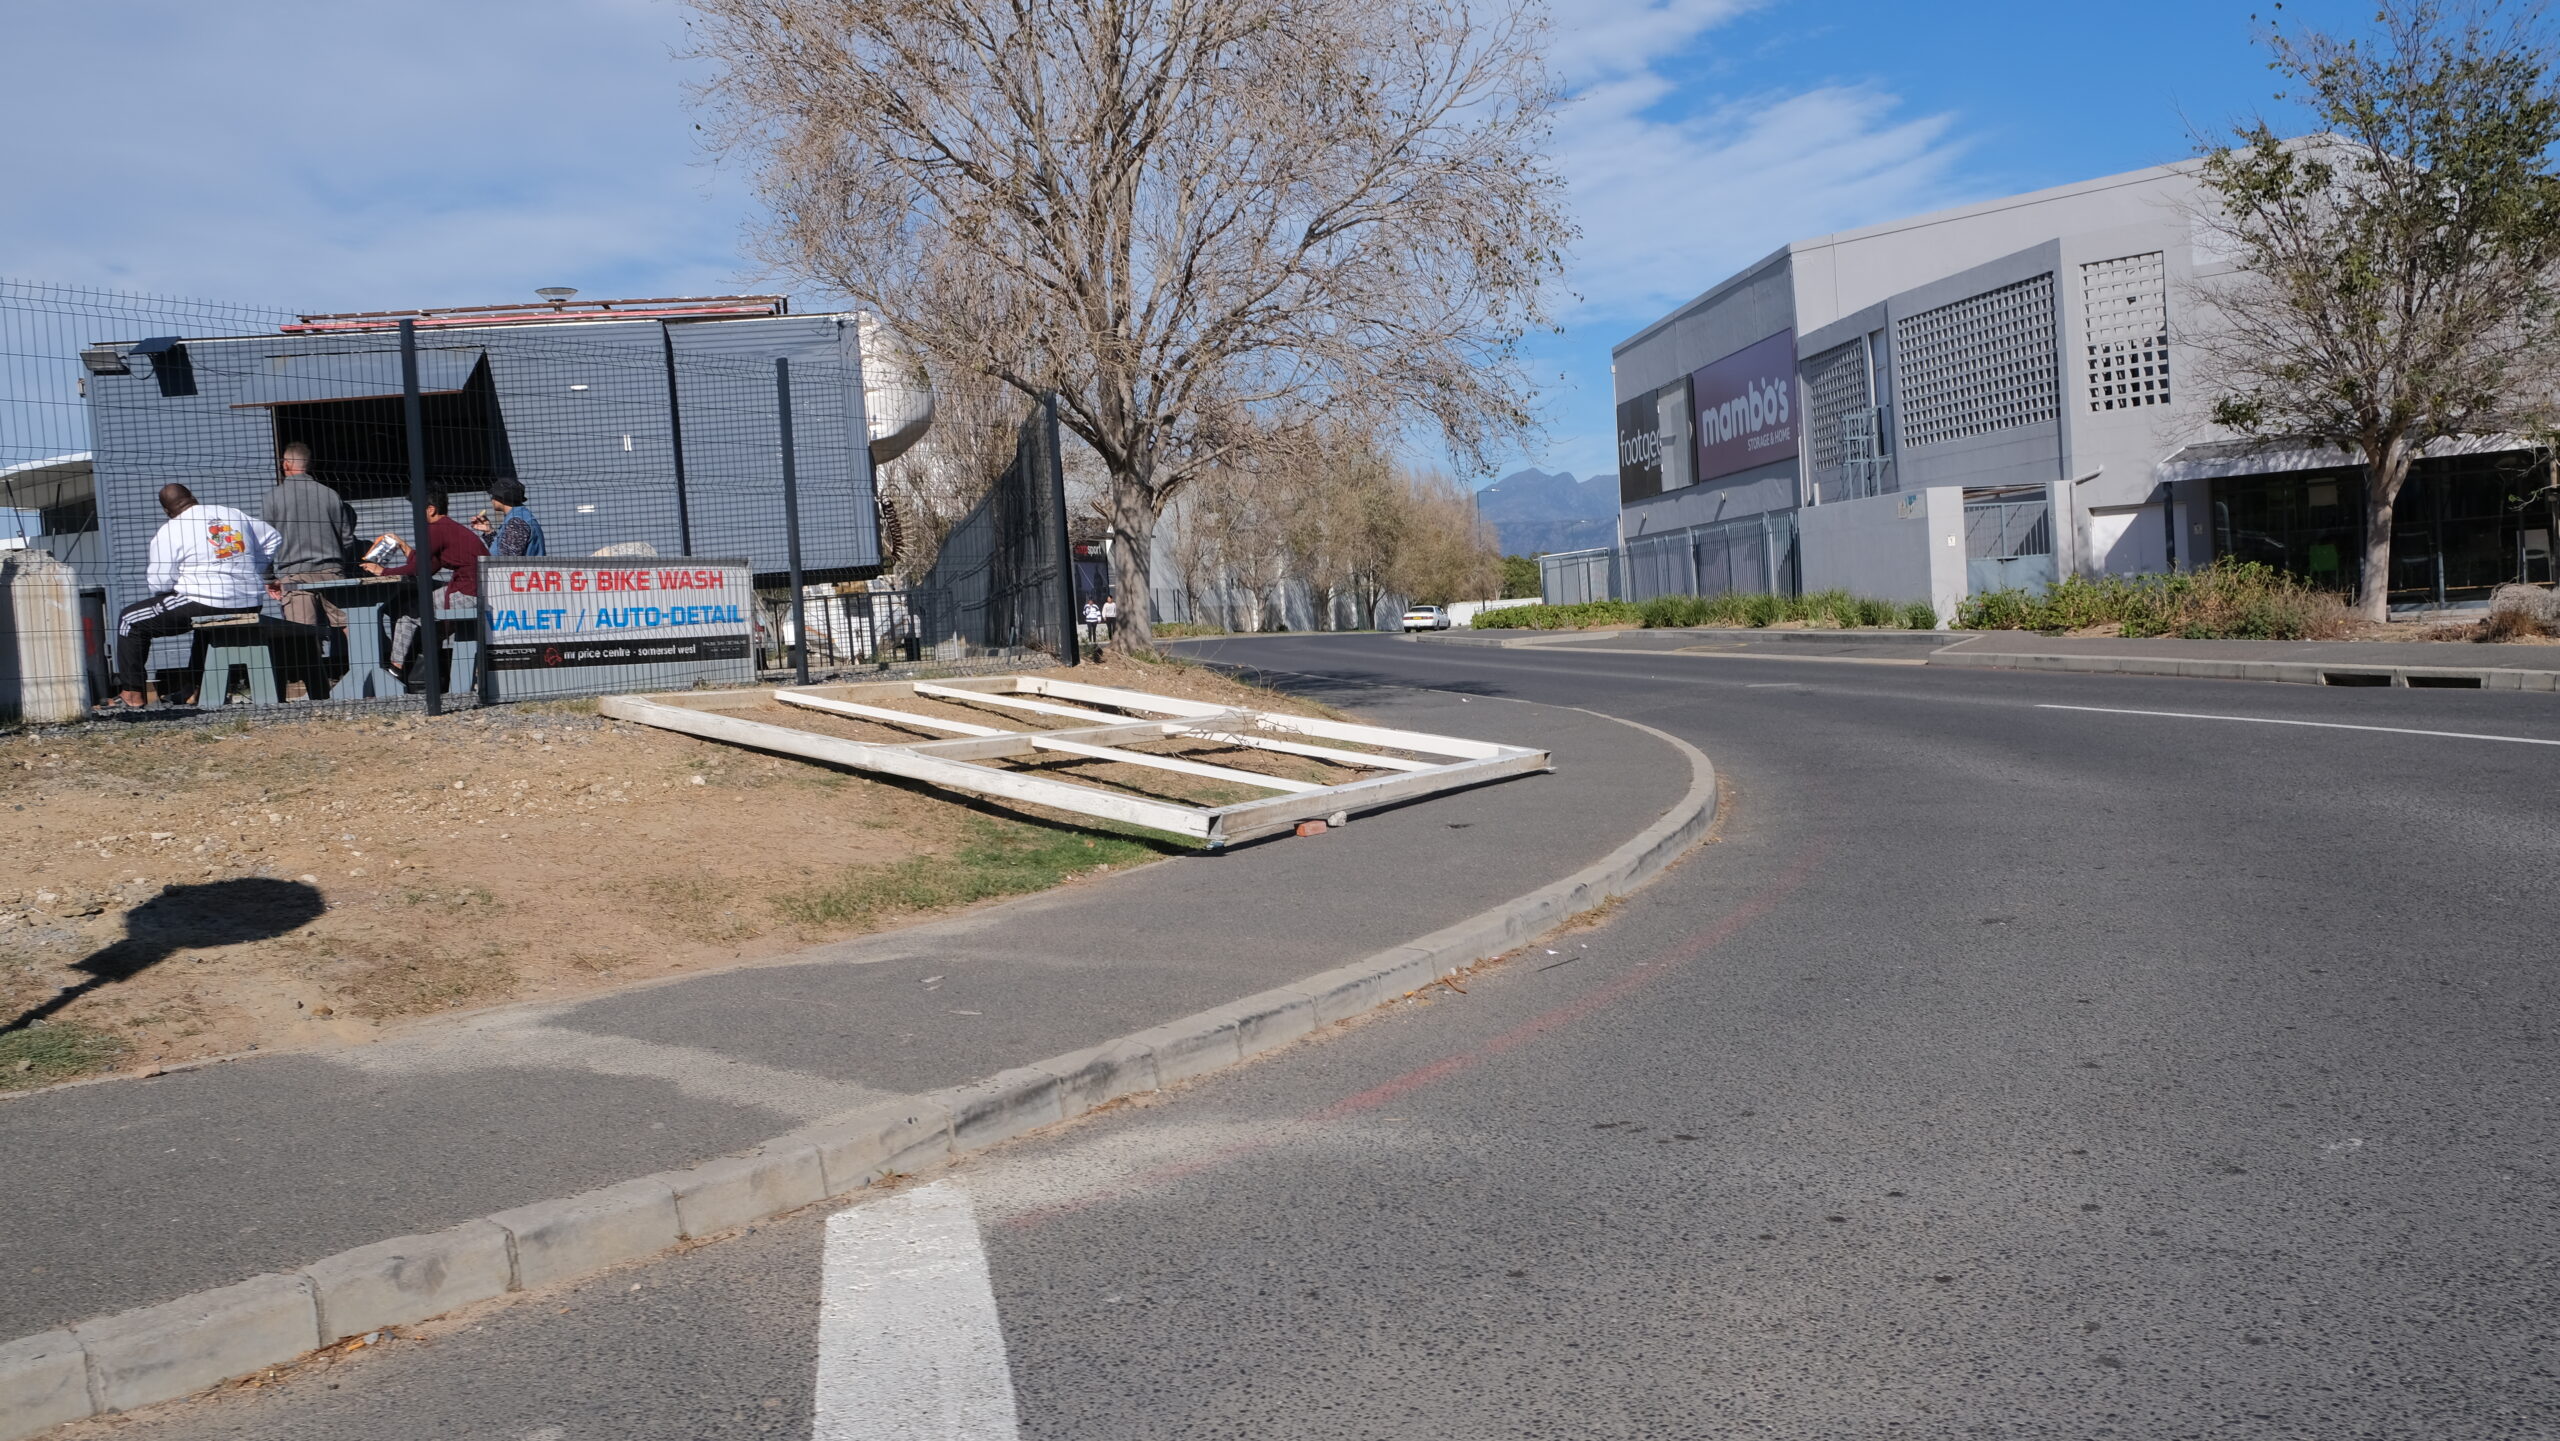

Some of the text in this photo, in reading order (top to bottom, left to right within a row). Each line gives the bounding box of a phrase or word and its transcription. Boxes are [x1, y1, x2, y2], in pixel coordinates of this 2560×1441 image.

[1702, 376, 1789, 447] mambo's
[1747, 433, 1770, 451] STORAGE
[1775, 427, 1791, 443] HOME
[510, 570, 724, 592] CAR & BIKE WASH
[485, 605, 744, 633] VALET / AUTO-DETAIL
[563, 651, 575, 660] mr
[577, 647, 601, 661] price
[602, 647, 631, 658] centre
[637, 645, 676, 656] somerset
[677, 644, 697, 655] west
